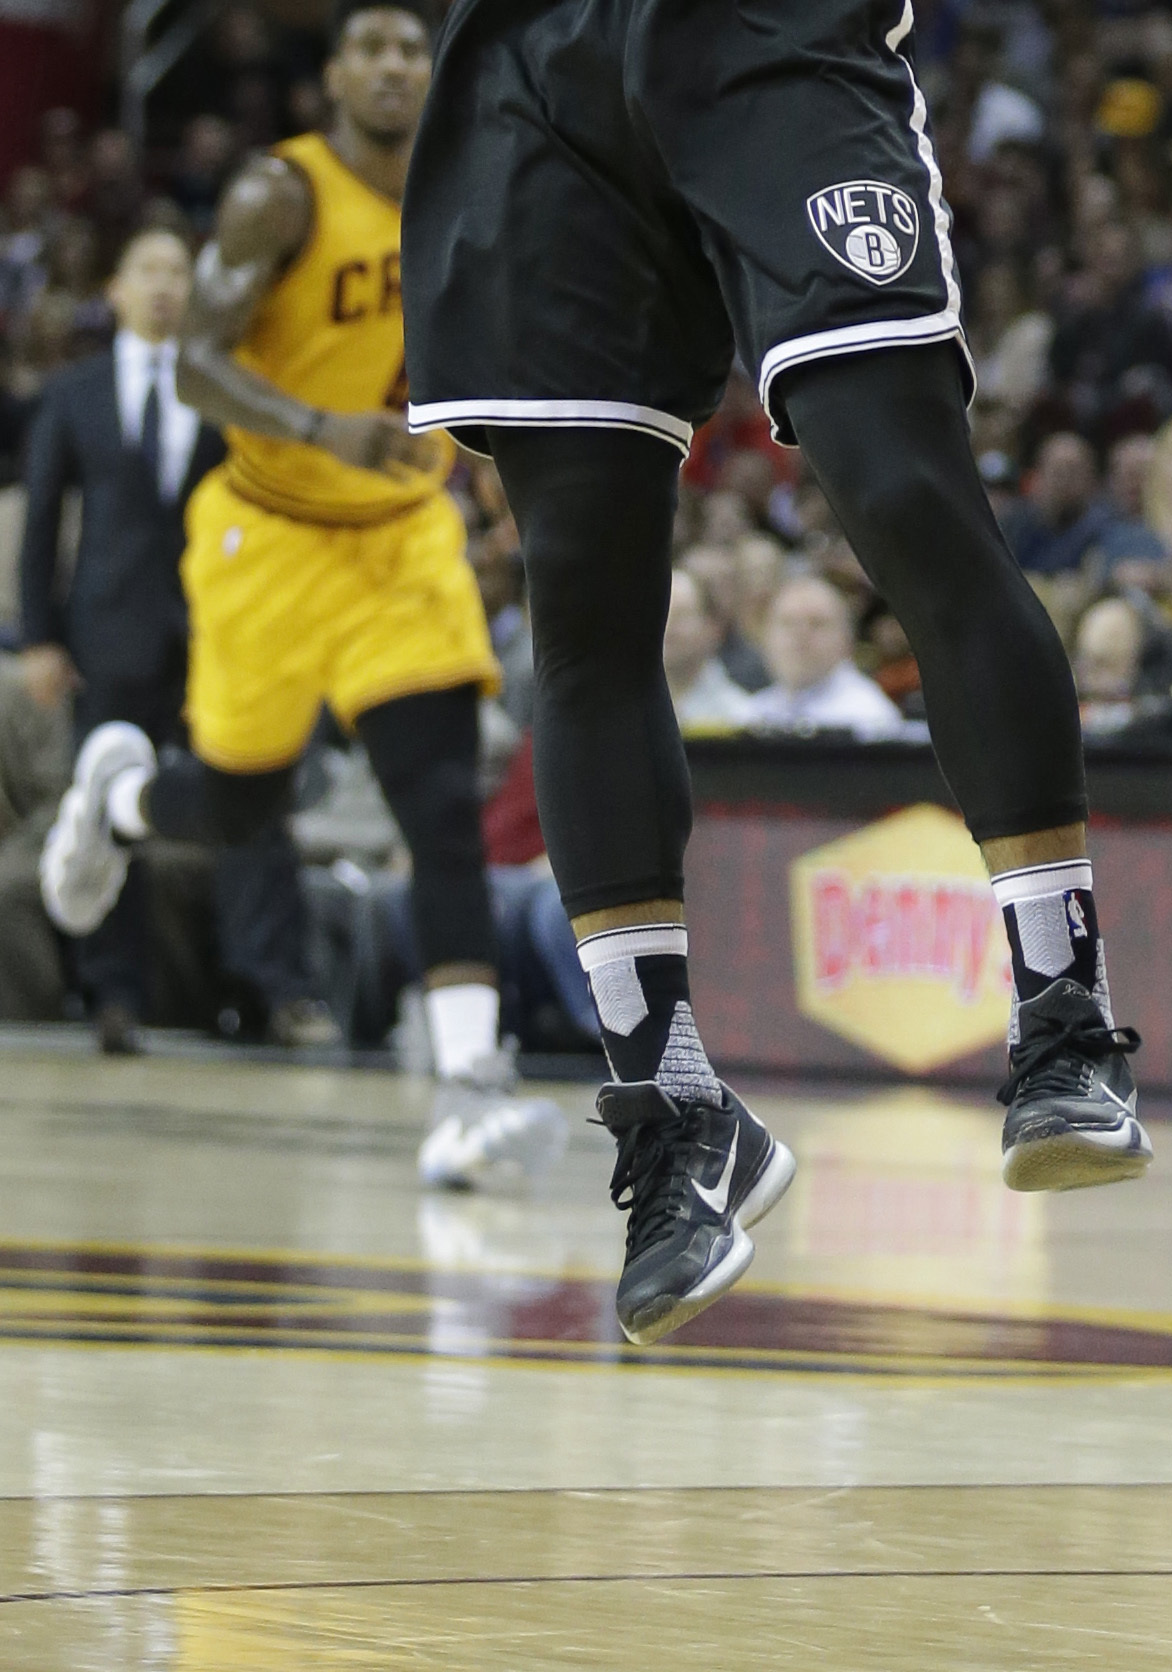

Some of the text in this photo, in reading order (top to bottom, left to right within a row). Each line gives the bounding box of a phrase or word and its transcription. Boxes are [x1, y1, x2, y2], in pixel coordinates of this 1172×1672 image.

[816, 185, 915, 235] NETS
[864, 231, 885, 268] B
[812, 873, 1013, 1001] Denny
